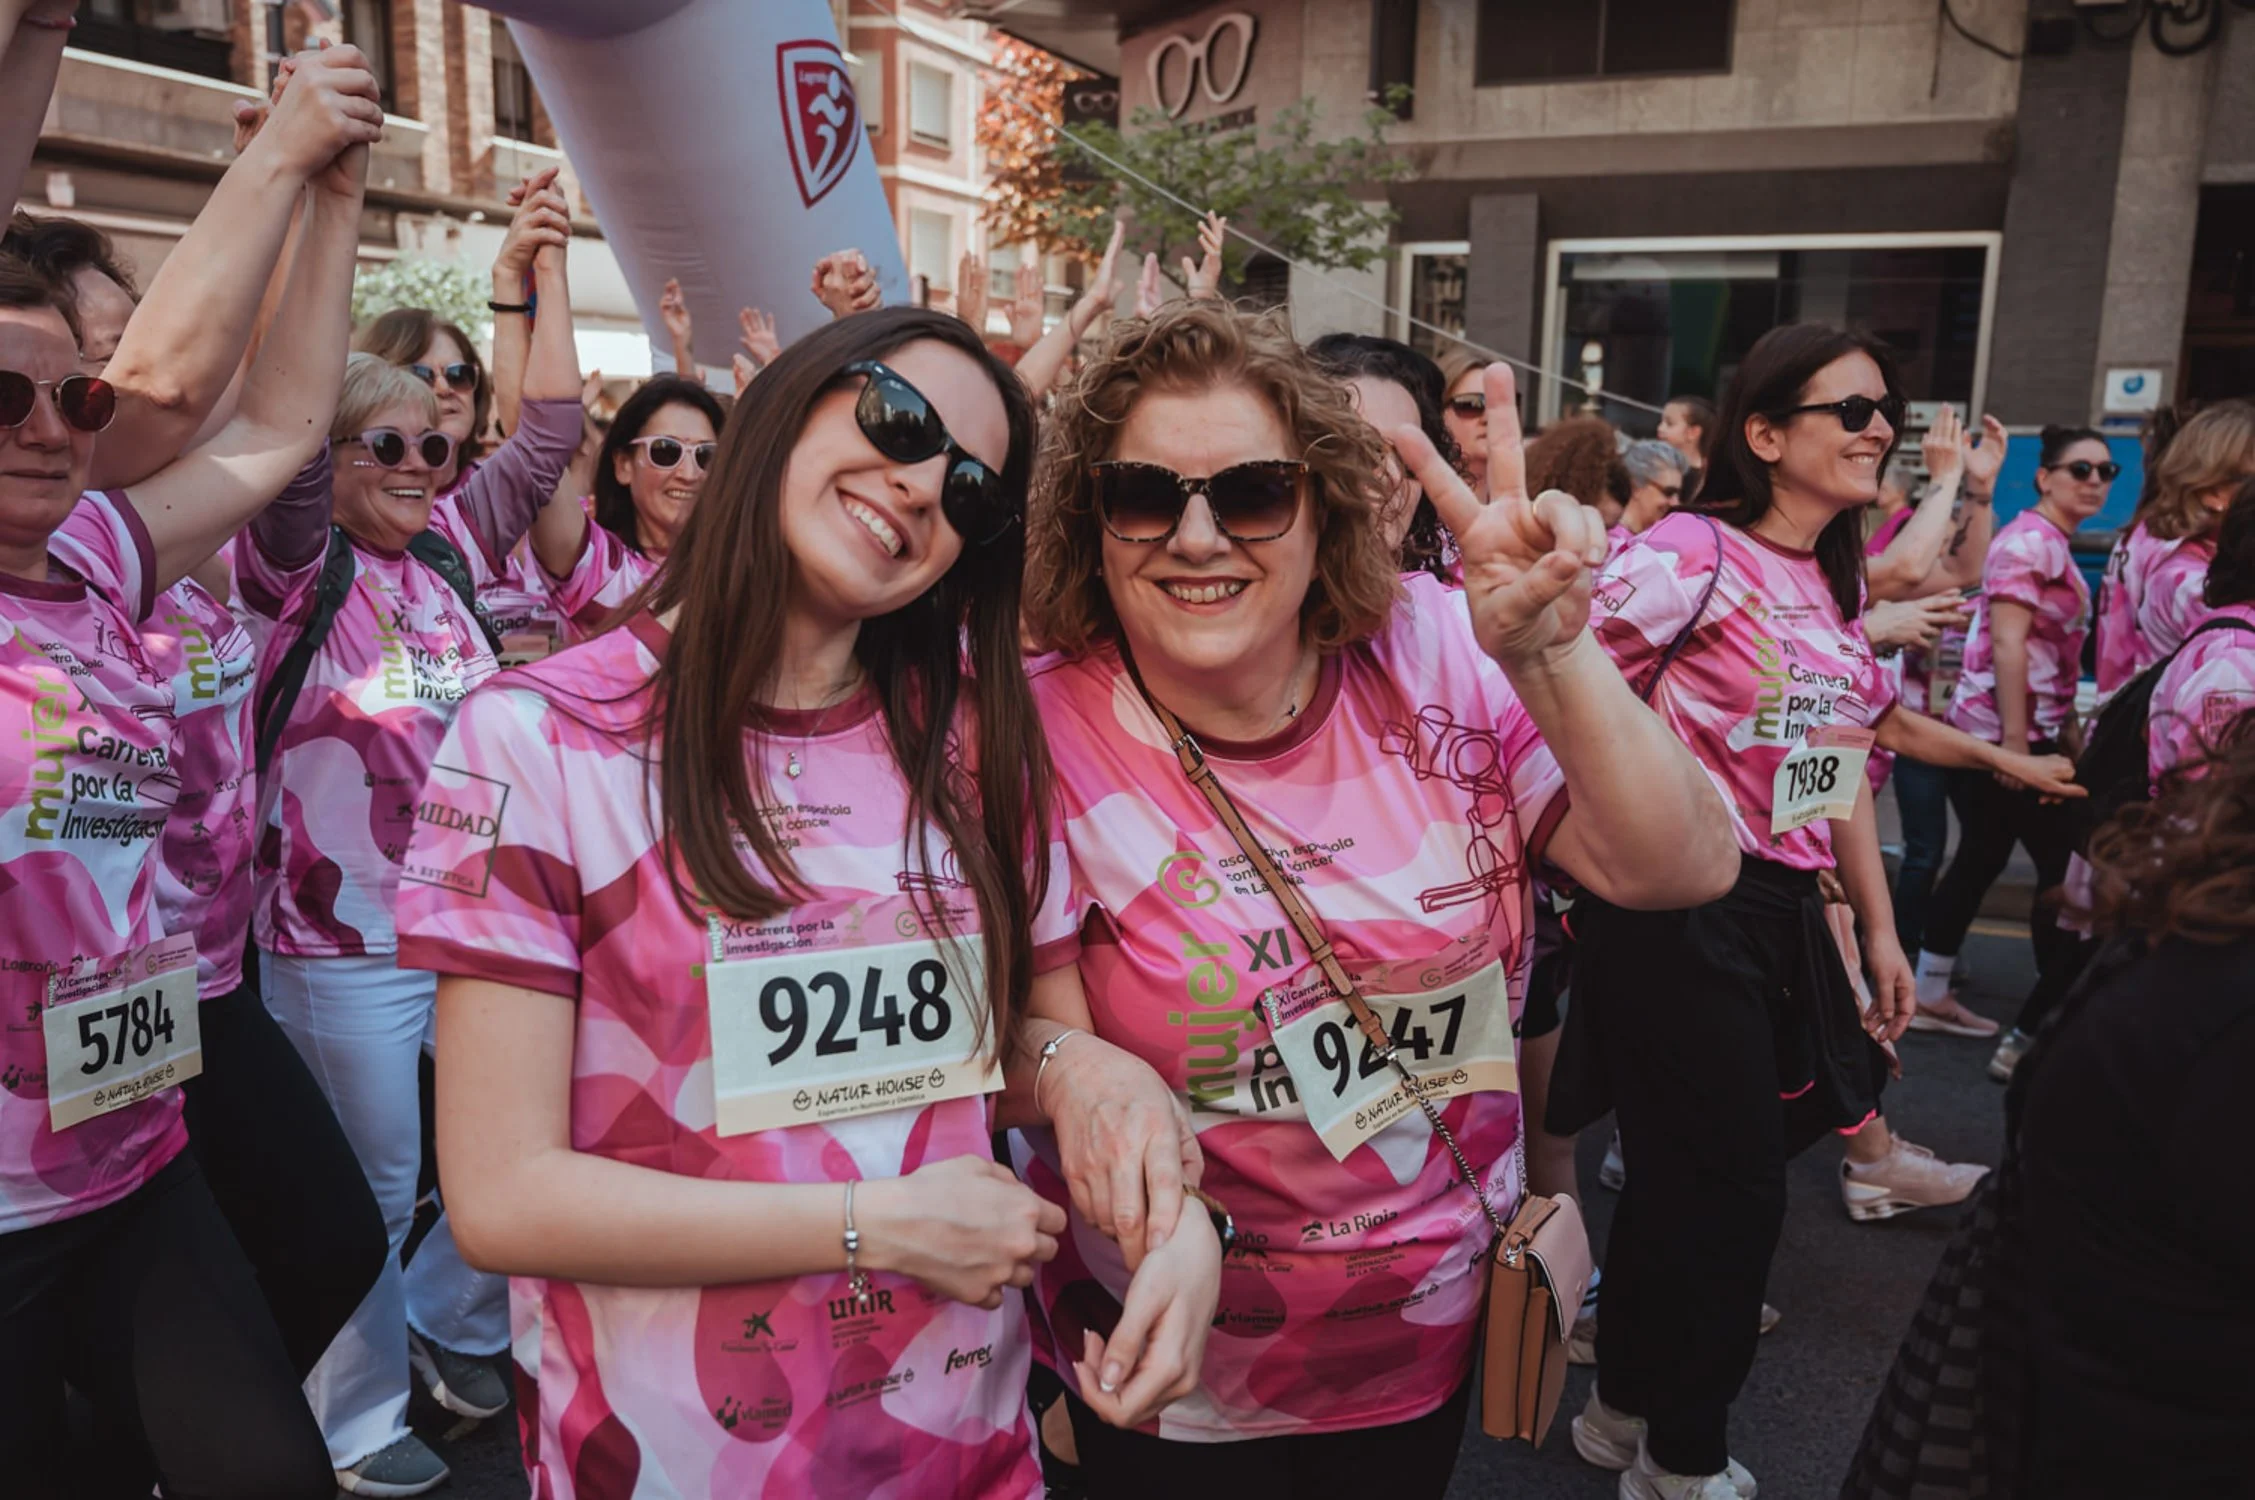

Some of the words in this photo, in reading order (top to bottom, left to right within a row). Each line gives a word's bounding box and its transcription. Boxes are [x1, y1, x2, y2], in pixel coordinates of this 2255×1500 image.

[1788, 663, 1850, 690] Carrera
[1787, 695, 1817, 716] por
[1819, 693, 1831, 715] la
[22, 674, 79, 841] mujer
[71, 772, 109, 806] por
[113, 771, 135, 803] la
[1787, 756, 1840, 802] 7938
[723, 923, 742, 939] XI
[745, 924, 794, 937] Carrera
[796, 922, 819, 935] por
[821, 919, 834, 931] la
[1239, 928, 1294, 973] XI
[759, 959, 951, 1067] 9248
[1281, 988, 1340, 1021] investigació
[78, 990, 175, 1075] 5784
[1313, 994, 1466, 1098] 9247
[815, 1083, 872, 1107] NATUR
[876, 1075, 925, 1096] HOUSE
[1330, 1222, 1351, 1238] La
[944, 1344, 993, 1375] ferrer
